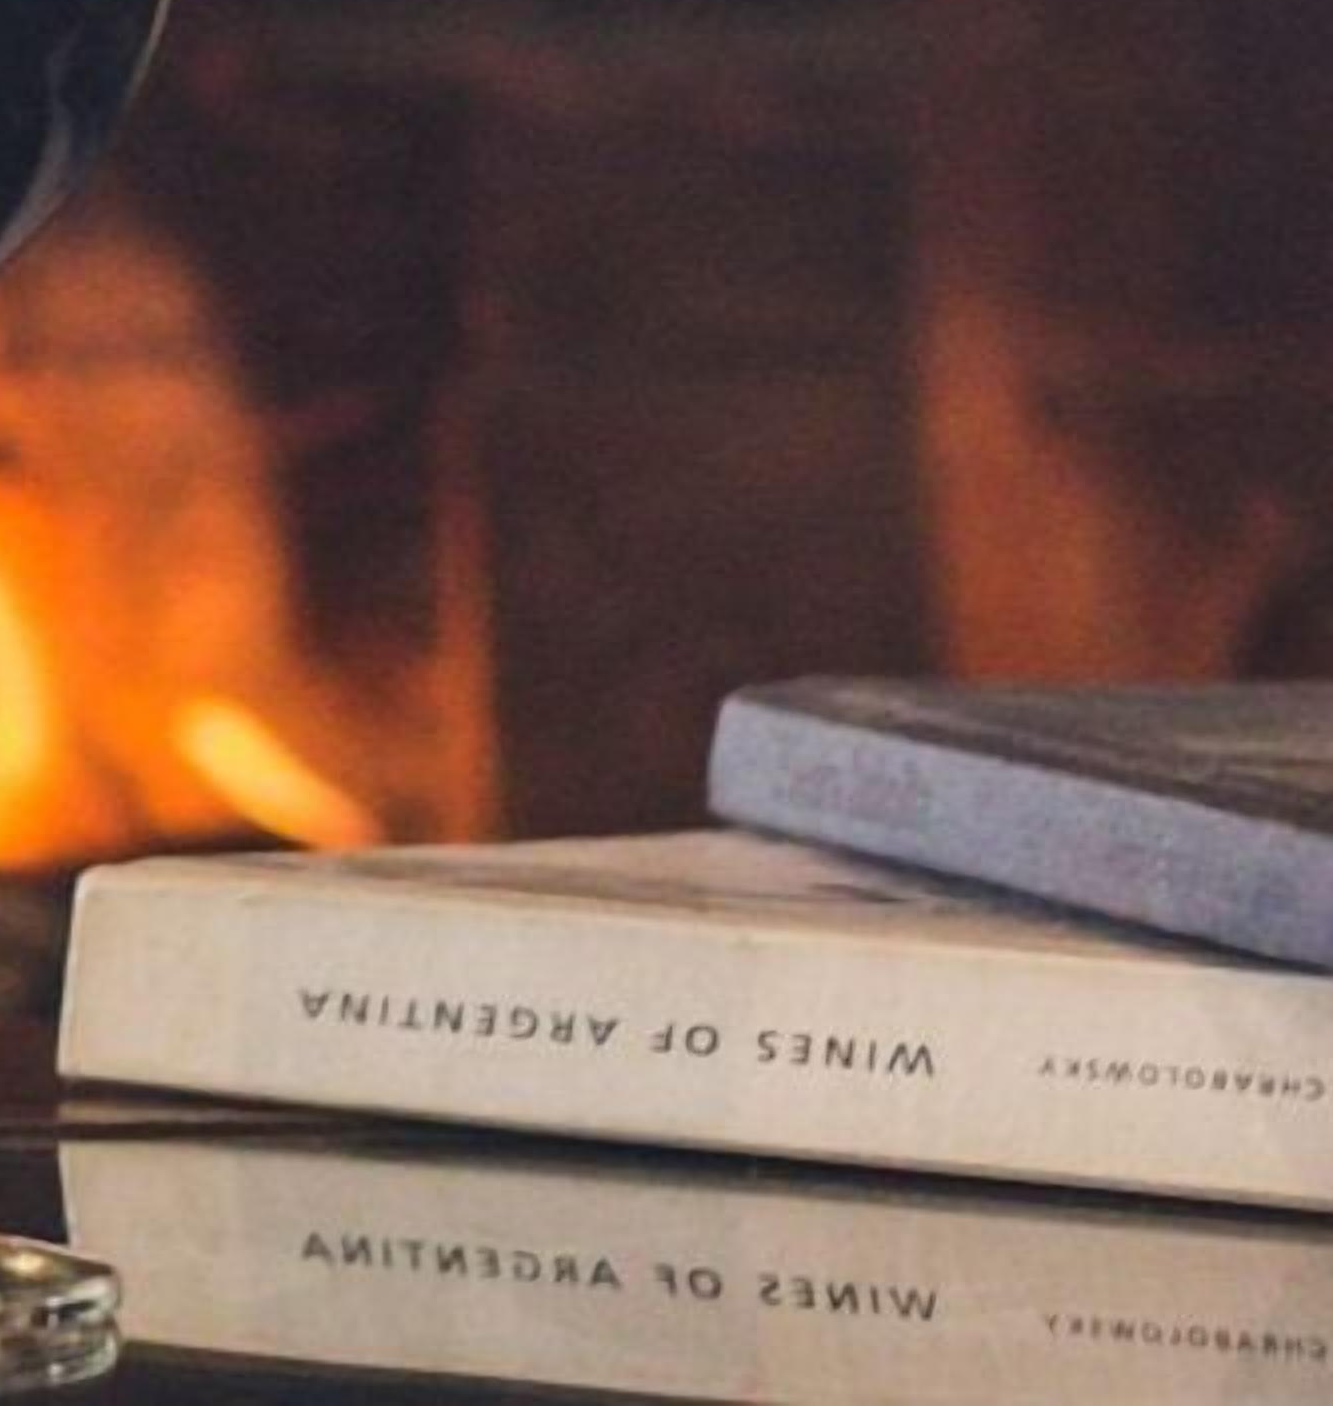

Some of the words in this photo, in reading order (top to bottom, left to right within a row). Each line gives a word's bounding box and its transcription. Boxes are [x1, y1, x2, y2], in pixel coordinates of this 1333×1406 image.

[298, 989, 619, 1048] ARGENTINA
[648, 1021, 722, 1058] OF
[756, 1028, 936, 1078] WINES
[1037, 1055, 1327, 1102] CHRABOLOWSKY
